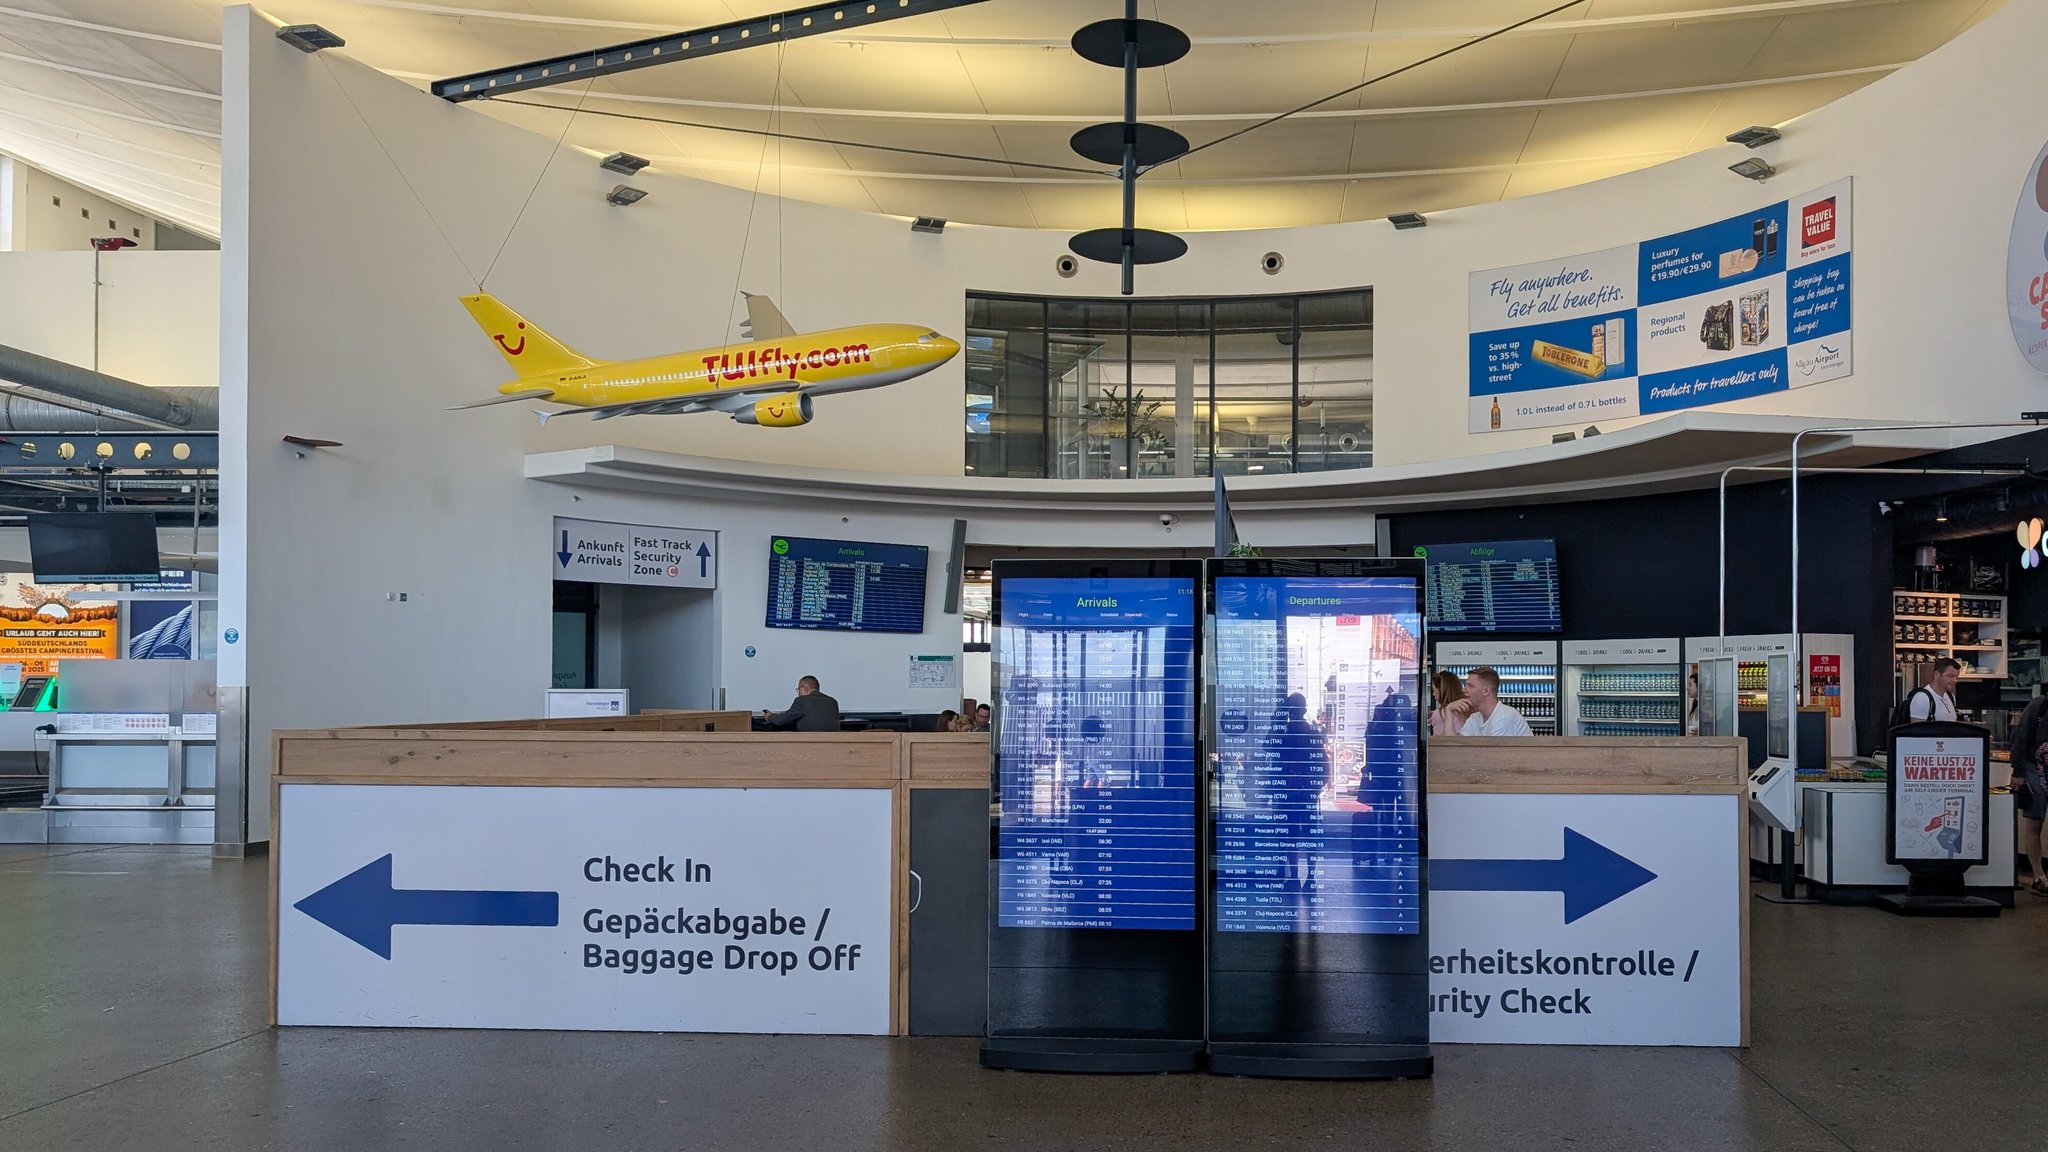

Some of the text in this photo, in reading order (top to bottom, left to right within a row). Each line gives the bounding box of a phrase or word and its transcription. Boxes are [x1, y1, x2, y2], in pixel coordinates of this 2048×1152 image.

[1804, 208, 1834, 226] TRAVEL
[1806, 220, 1830, 237] VALUE
[1652, 247, 1680, 261] Luxury
[1809, 248, 1820, 256] more
[1651, 252, 1704, 272] perfumes for
[1651, 260, 1712, 282] €19.90/€29.90
[1792, 268, 1840, 290] Shopping bag
[1490, 267, 1593, 302] Fly anywhere.
[1793, 283, 1845, 304] can be taken on
[1508, 286, 1624, 318] Get all benefits.
[1793, 298, 1838, 318] board free of
[1650, 312, 1686, 328] Regional
[1793, 319, 1819, 334] charge!
[1650, 324, 1686, 339] products
[1488, 340, 1520, 352] Save up
[702, 343, 871, 383] TUIfly.com
[1488, 354, 1497, 362] to
[1542, 345, 1590, 370] TOBLERONE
[1794, 352, 1839, 370] Allgäu Airport
[1502, 361, 1523, 372] high-
[1488, 373, 1512, 383] street
[1650, 363, 1779, 400] Products for travellers only
[1536, 403, 1565, 414] instead
[1567, 400, 1576, 410] of
[1598, 396, 1627, 407] bottles
[577, 540, 624, 553] Ankunft
[634, 537, 692, 551] Fast Track
[838, 548, 864, 556] Arrivals
[1470, 548, 1494, 556] Abflüge
[577, 554, 622, 567] Arrivals
[634, 551, 682, 565] Security
[634, 565, 662, 575] Zone
[1077, 597, 1118, 608] Arrivals
[1289, 596, 1342, 607] Departures
[1904, 756, 1976, 766] KEINE LUST ZU
[1904, 767, 1976, 780] WARTEN?
[583, 856, 712, 883] Check In
[582, 907, 831, 941] Gepäckabgabe /
[583, 944, 862, 976] Baggage Drop Off
[1429, 948, 1700, 982] erheitskontrolle /
[1500, 988, 1592, 1014] Check
